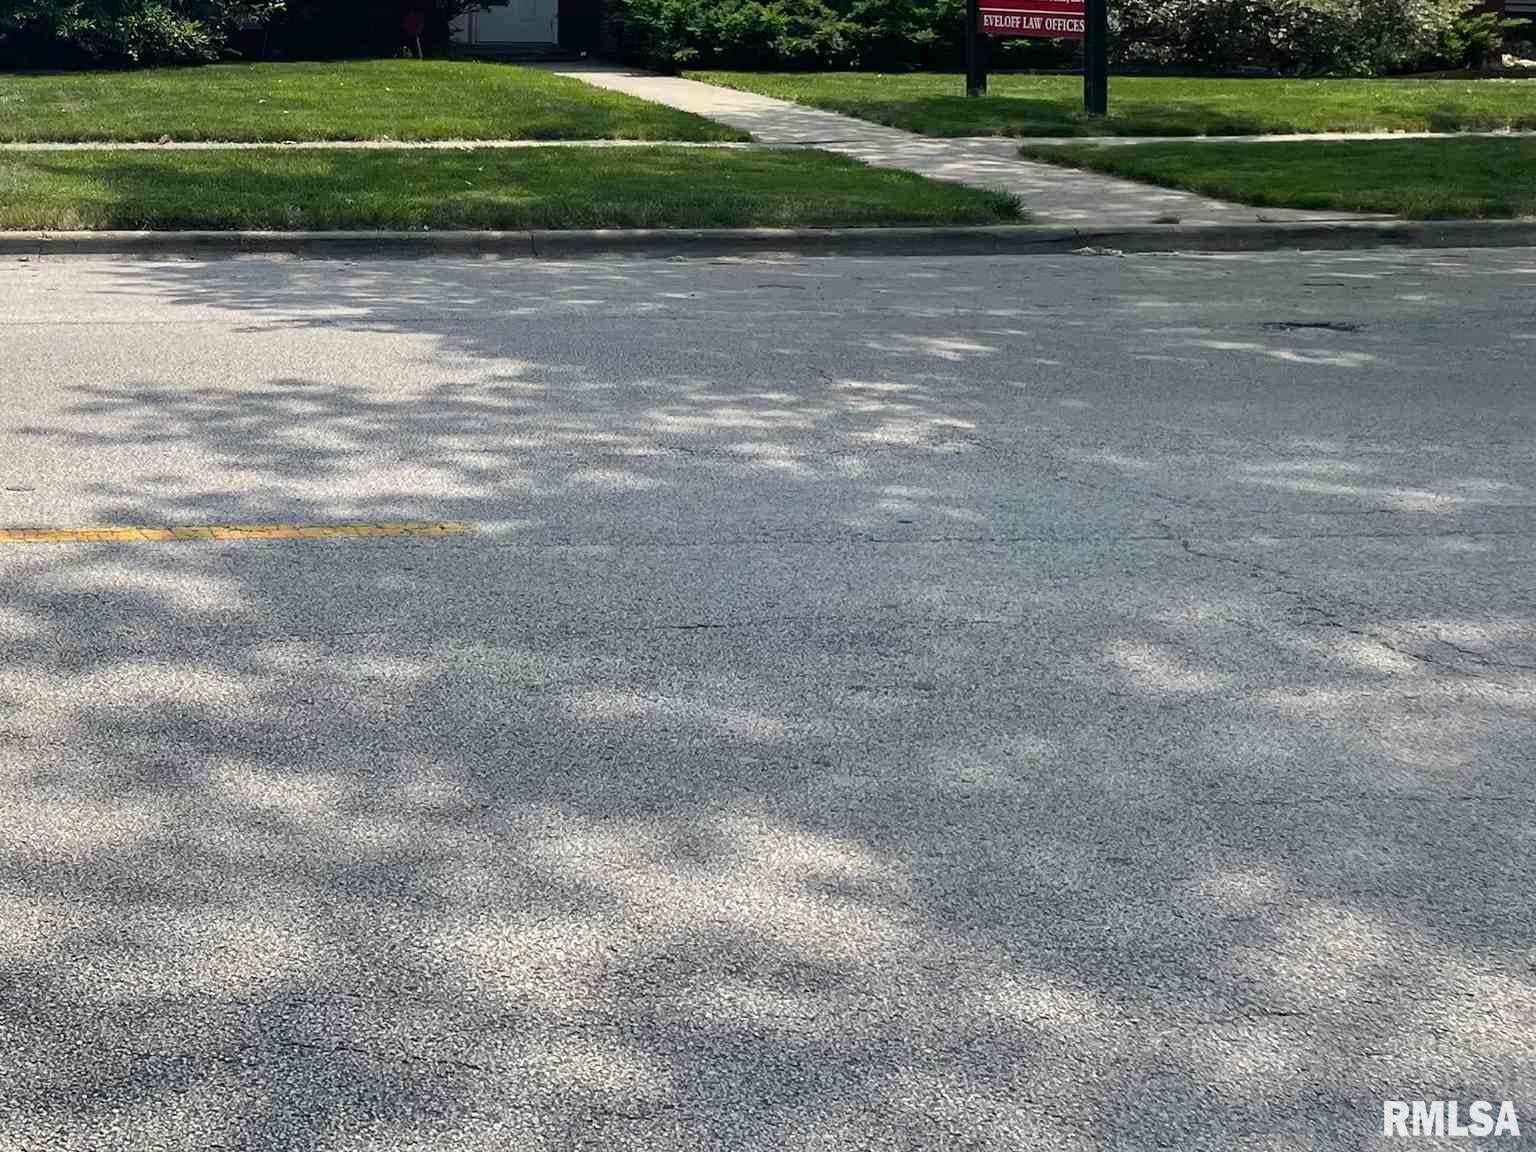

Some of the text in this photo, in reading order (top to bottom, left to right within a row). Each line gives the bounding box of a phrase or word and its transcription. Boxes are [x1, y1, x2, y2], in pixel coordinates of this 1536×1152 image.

[983, 14, 1086, 32] EVELOFF LAW OFFICES
